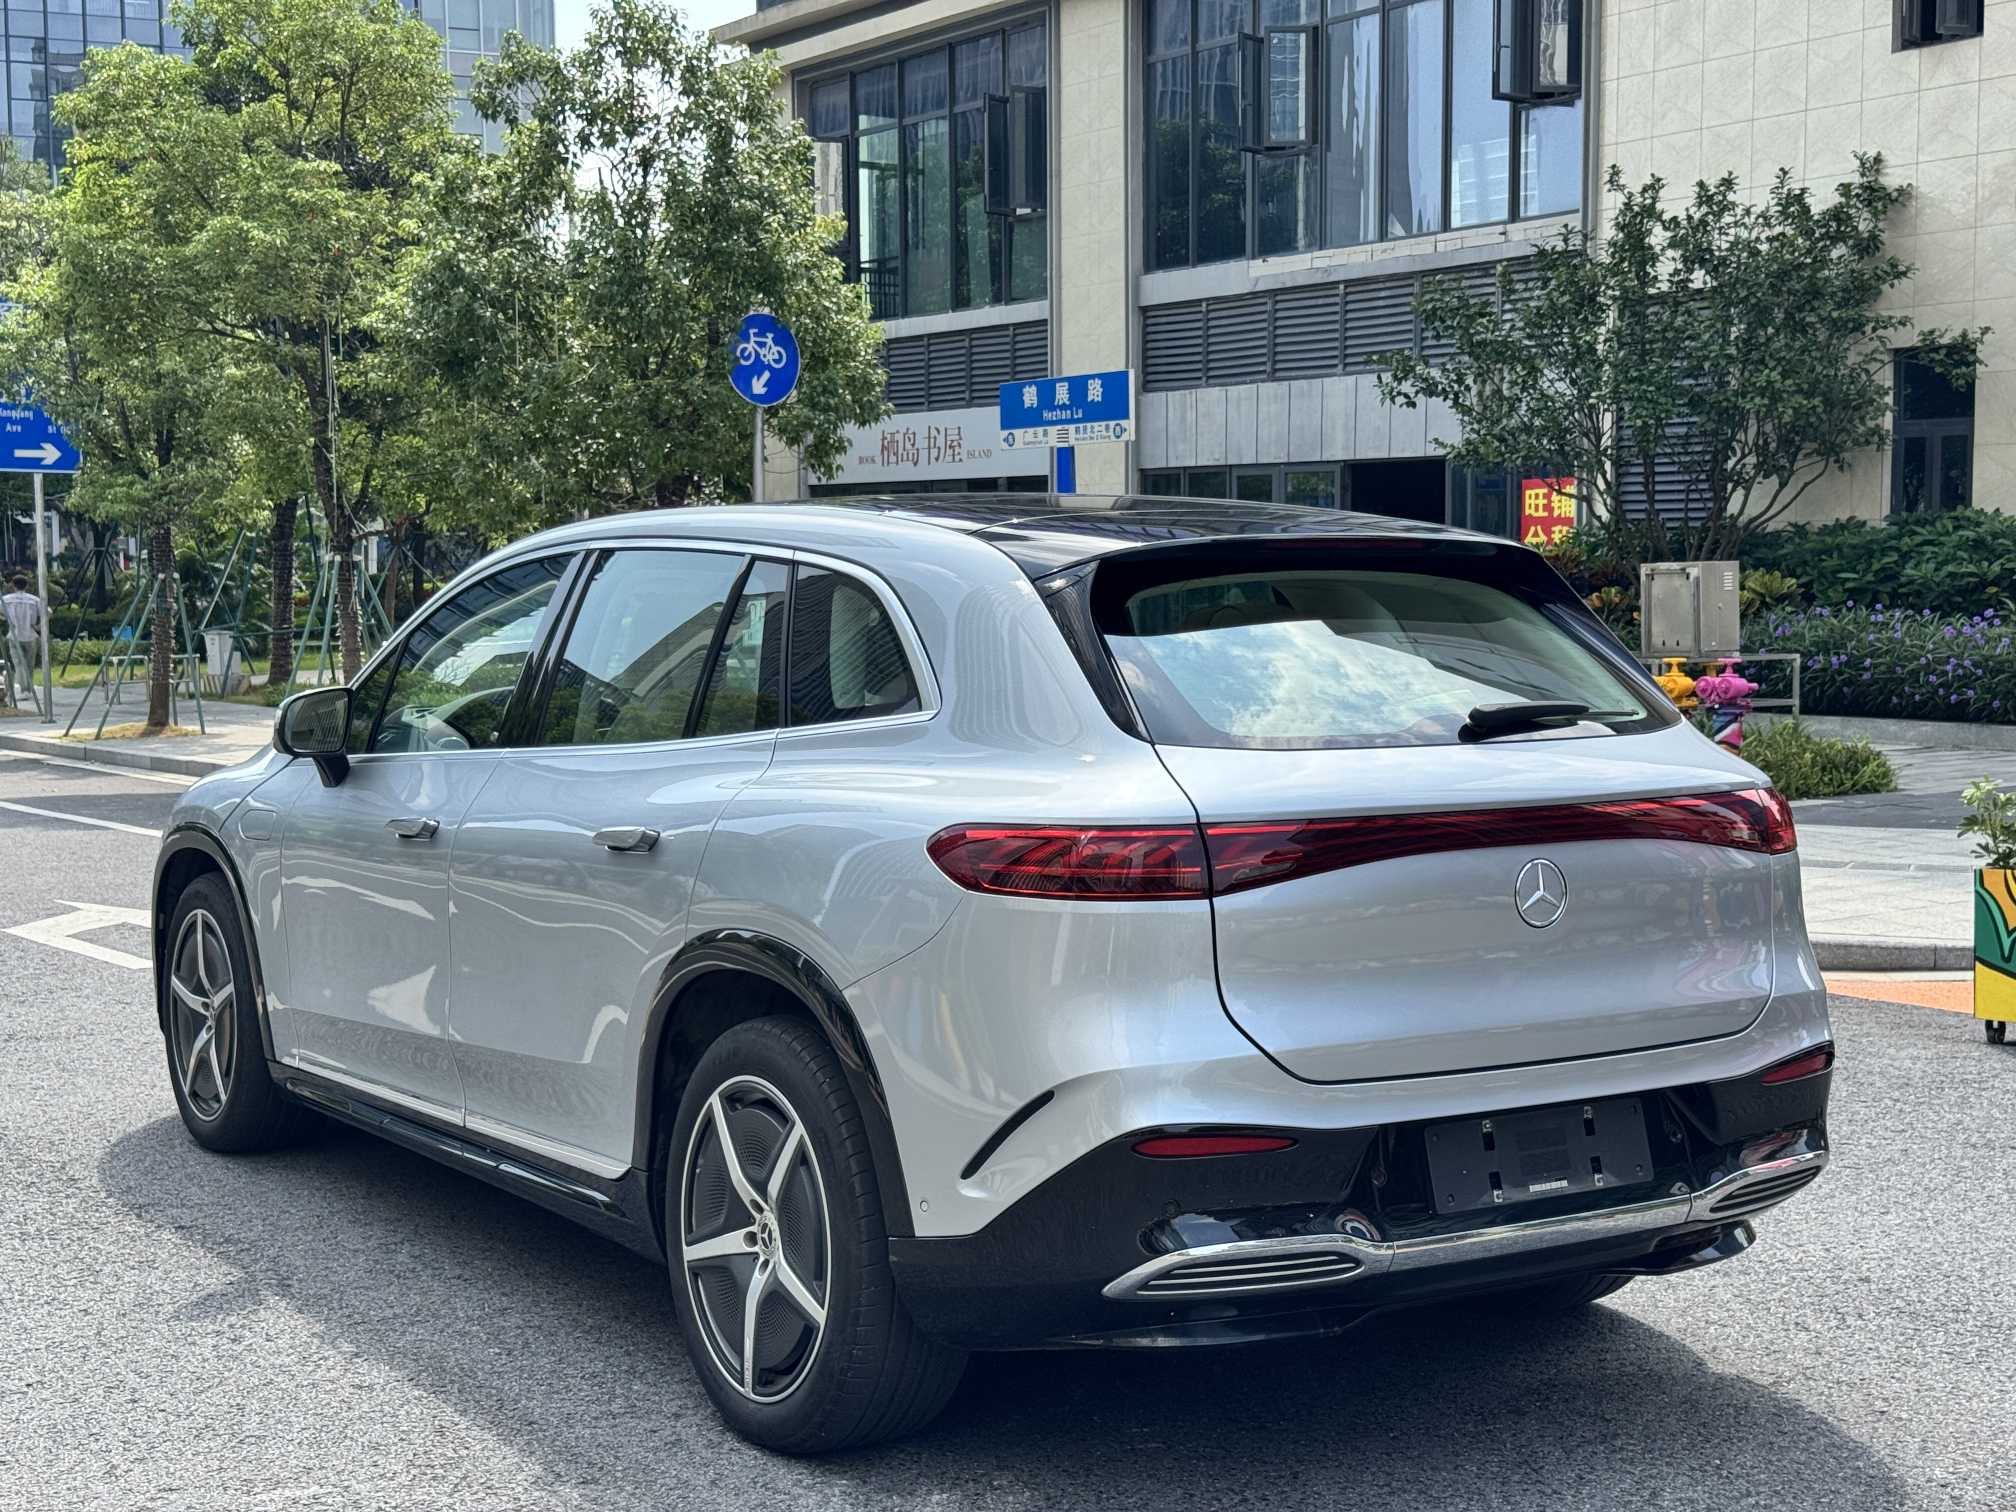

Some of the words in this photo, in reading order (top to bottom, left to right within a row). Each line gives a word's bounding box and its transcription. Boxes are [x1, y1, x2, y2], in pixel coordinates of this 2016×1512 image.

[1022, 377, 1104, 409] 鹤展路
[1042, 409, 1072, 422] Hezhan
[1073, 407, 1083, 419] Lu
[858, 455, 877, 465] BOOK
[880, 425, 964, 468] 栖岛书屋
[966, 448, 993, 460] ISLAND
